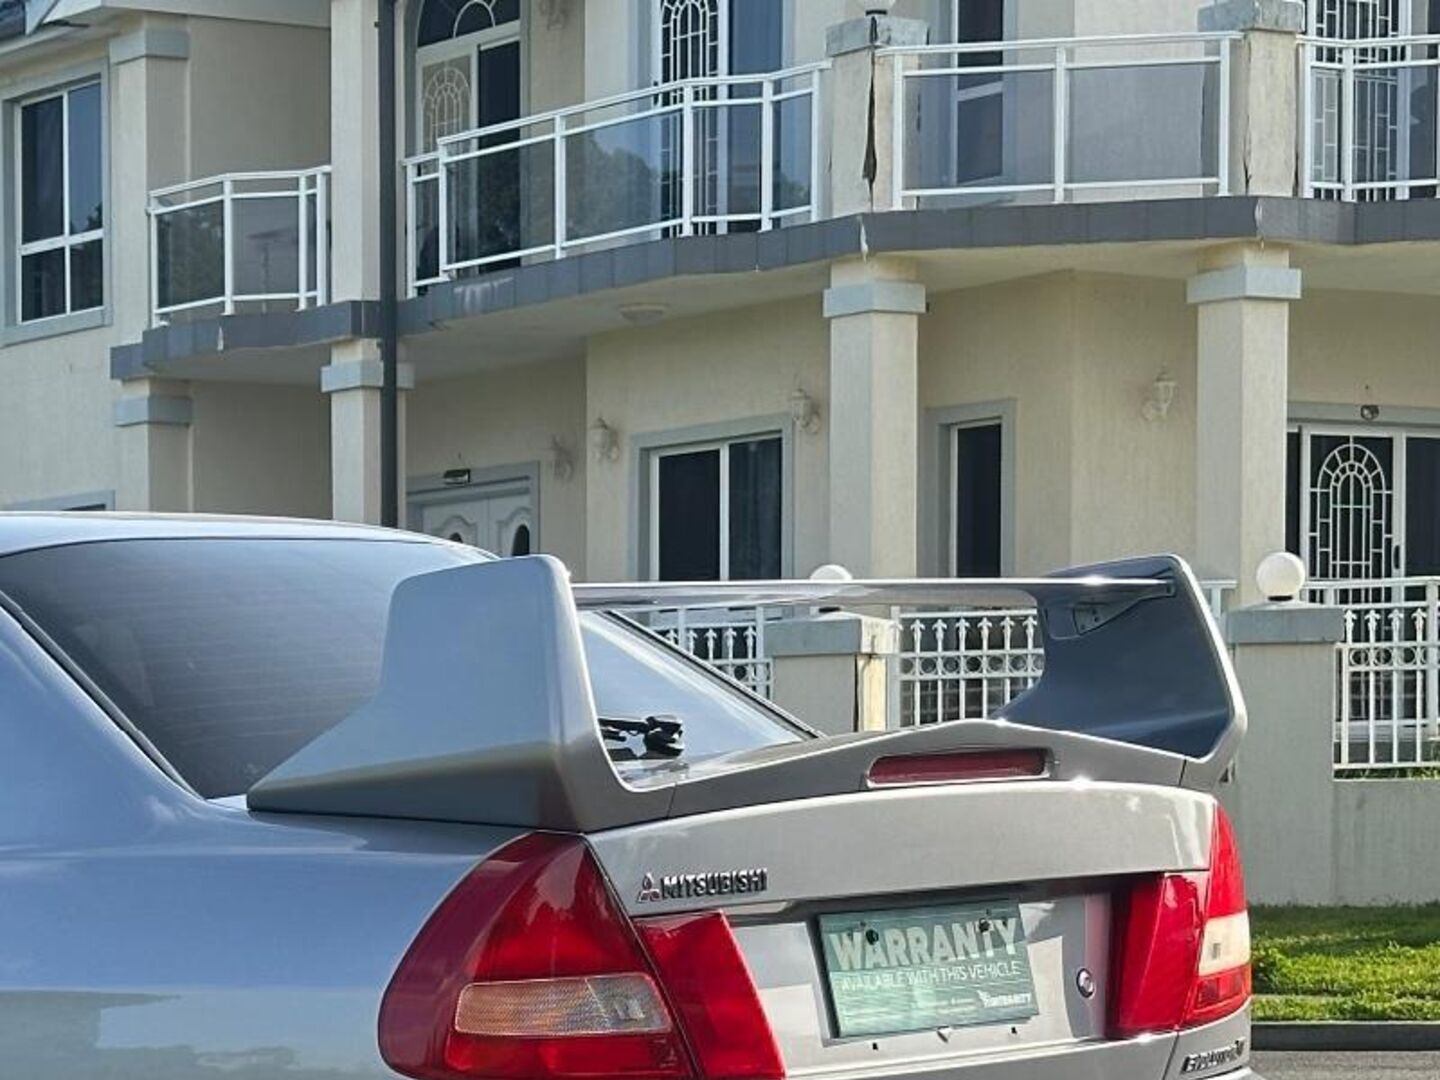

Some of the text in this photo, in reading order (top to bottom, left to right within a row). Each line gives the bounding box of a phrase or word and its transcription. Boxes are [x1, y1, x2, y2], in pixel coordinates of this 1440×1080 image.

[660, 868, 767, 899] MITSUBISHI
[829, 917, 1017, 970] WARRANTY
[837, 960, 1022, 991] AVAILABLE WITH THIS VEHICLE
